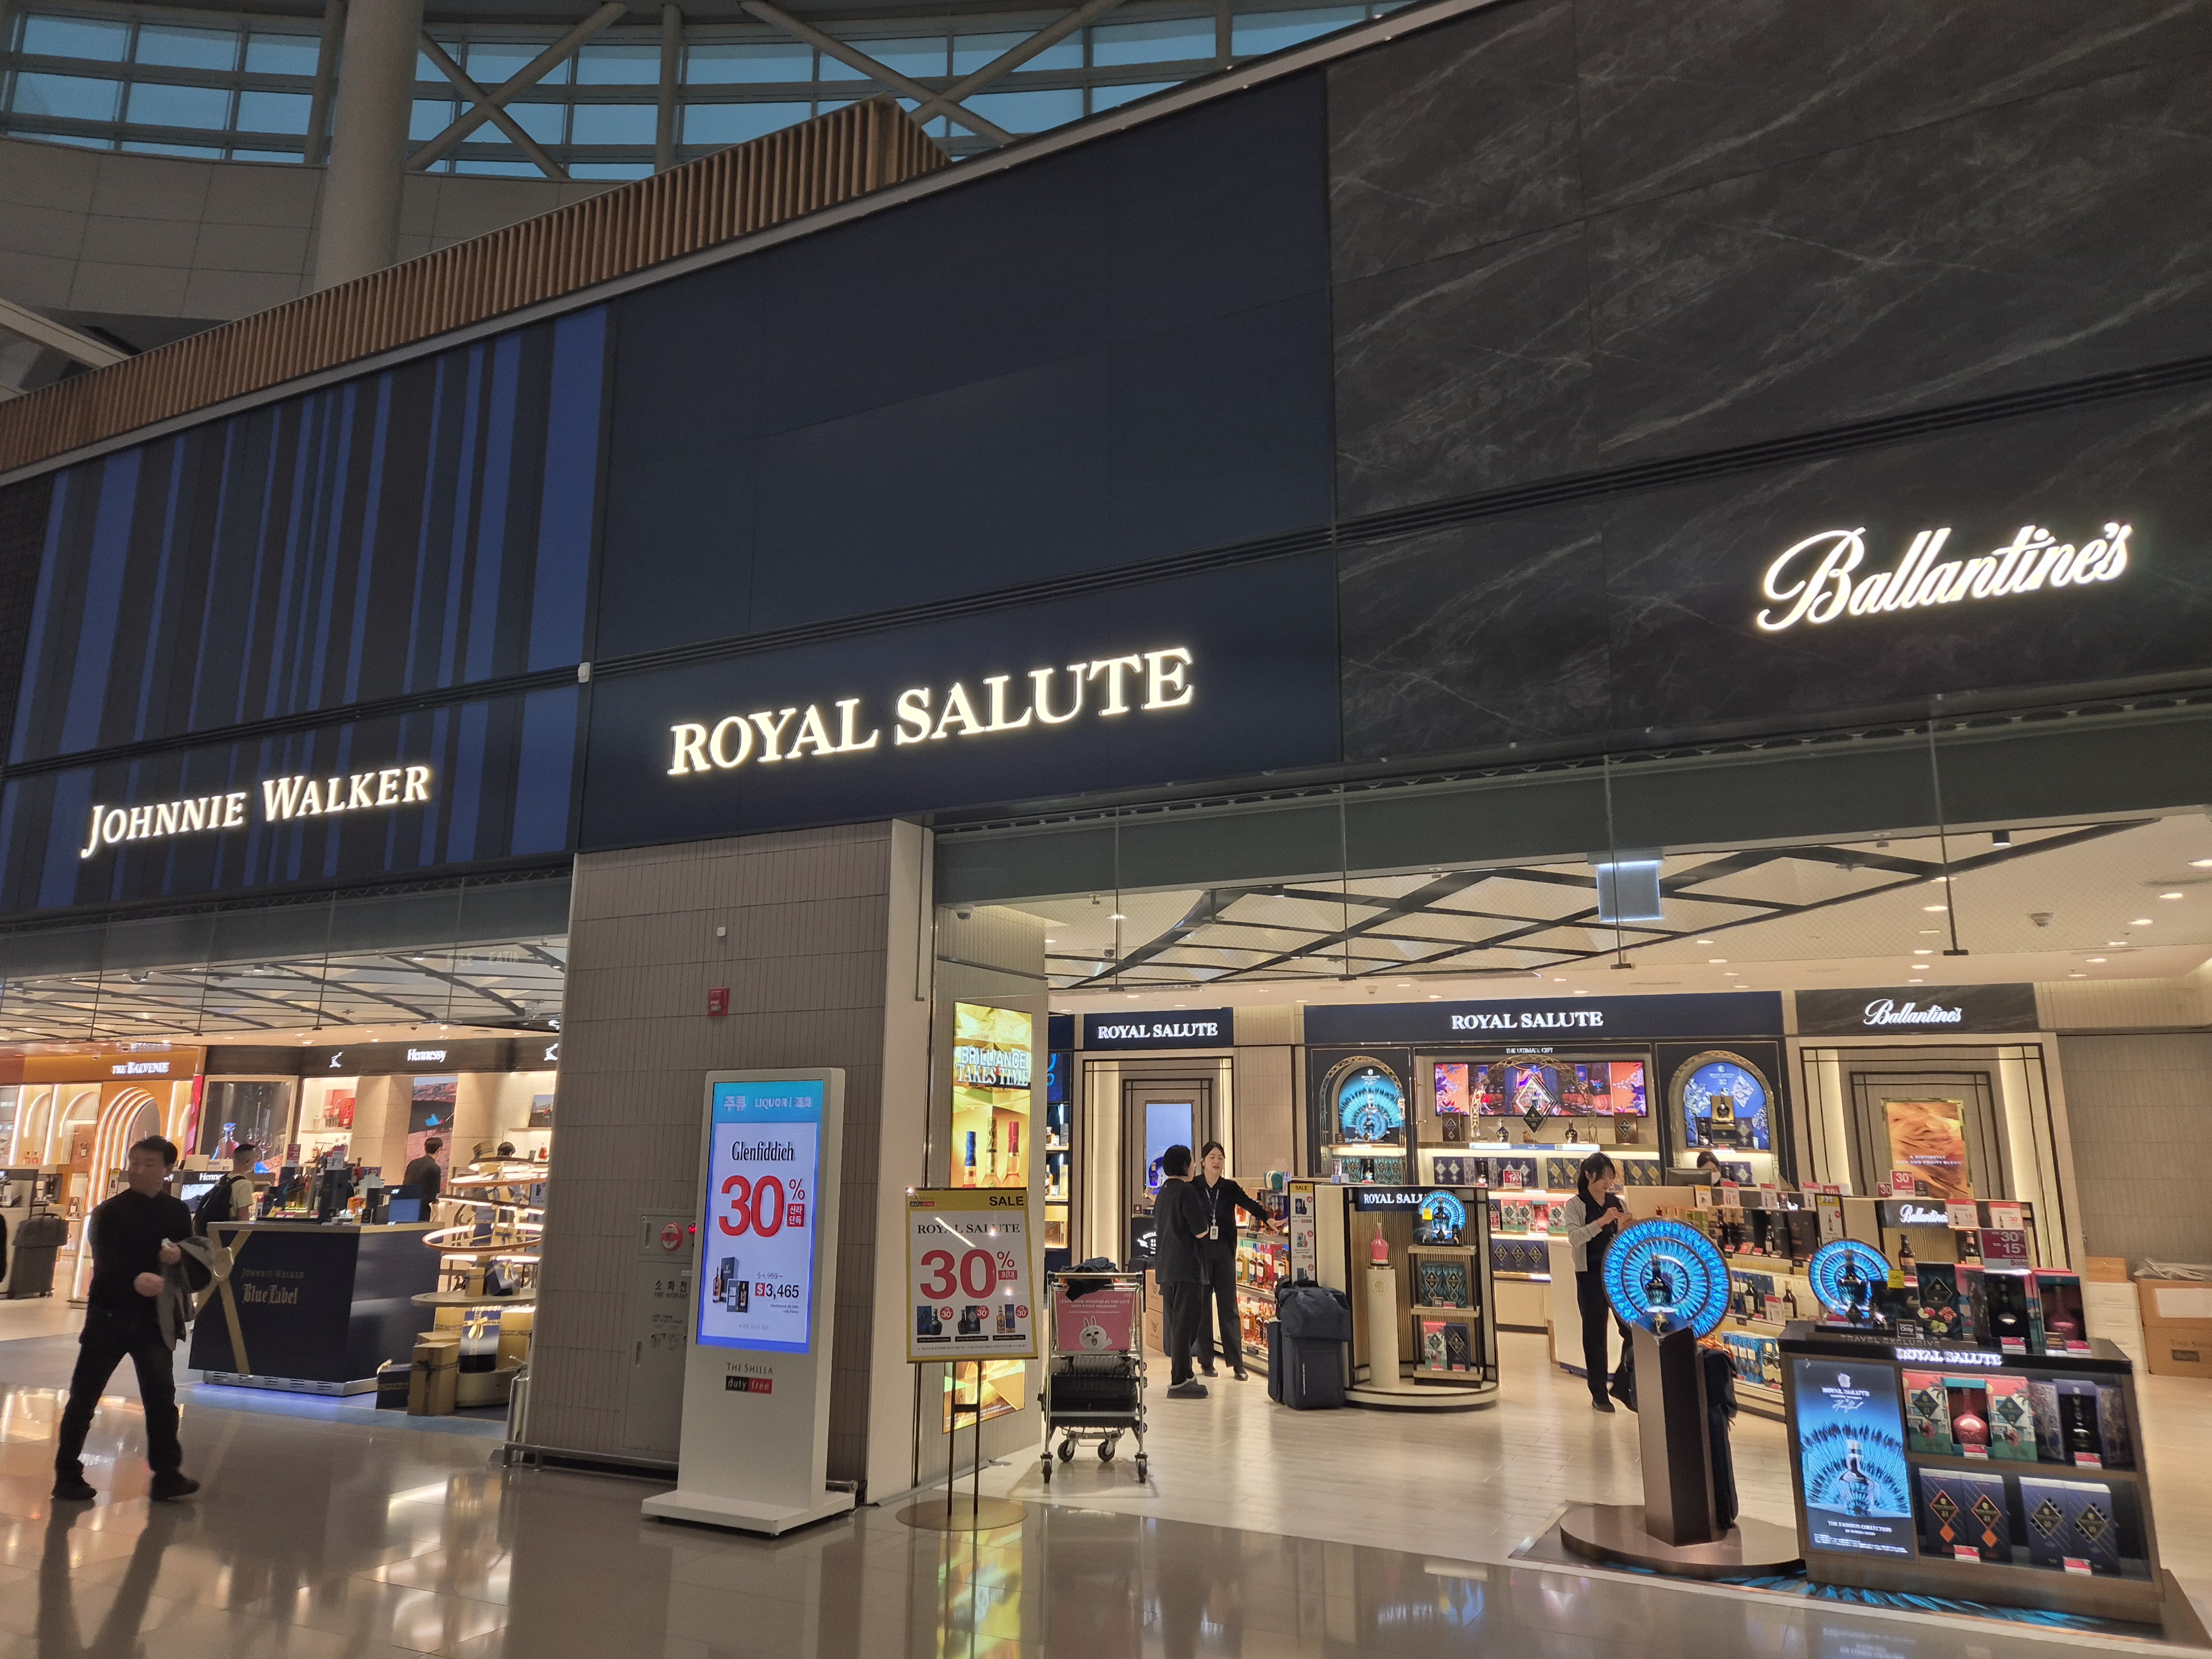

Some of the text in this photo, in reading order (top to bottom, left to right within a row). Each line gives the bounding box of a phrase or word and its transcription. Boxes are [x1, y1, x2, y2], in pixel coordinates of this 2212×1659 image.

[1756, 522, 2133, 630] Ballantine's
[667, 648, 1193, 776] ROYAL SALUTE
[80, 765, 432, 859] JOHNNIE WALKER
[1863, 999, 1961, 1025] Ballantine's
[1452, 1011, 1604, 1030] ROYAL SALUTE
[1098, 1022, 1218, 1039] ROYAL SALUTE
[408, 1048, 447, 1062] Hennessy
[961, 1046, 1027, 1070] BRILLIANCE
[112, 1061, 170, 1074] THE BALVENIE
[956, 1063, 1029, 1087] TAKES TIME
[724, 1095, 746, 1112] 주류
[754, 1097, 787, 1110] LIQUOR
[732, 1141, 794, 1161] Glenfiddich
[199, 1172, 226, 1181] Henne
[989, 1196, 1024, 1206] SALE
[1364, 1193, 1395, 1204] ROYAL
[789, 1205, 802, 1215] 신라
[789, 1215, 802, 1225] 단독
[966, 1223, 1020, 1234] SALUTE
[241, 1267, 273, 1279] JOHNNIE
[1001, 1270, 1015, 1279] 최대
[242, 1283, 299, 1305] Blue Label
[755, 1282, 800, 1300] $3,465
[1840, 1335, 1940, 1348] TRAVEL EXCLUSIVE
[1895, 1347, 2002, 1366] ROYAL SALUTE
[727, 1362, 773, 1374] THE SHILLA
[728, 1378, 769, 1391] duty free
